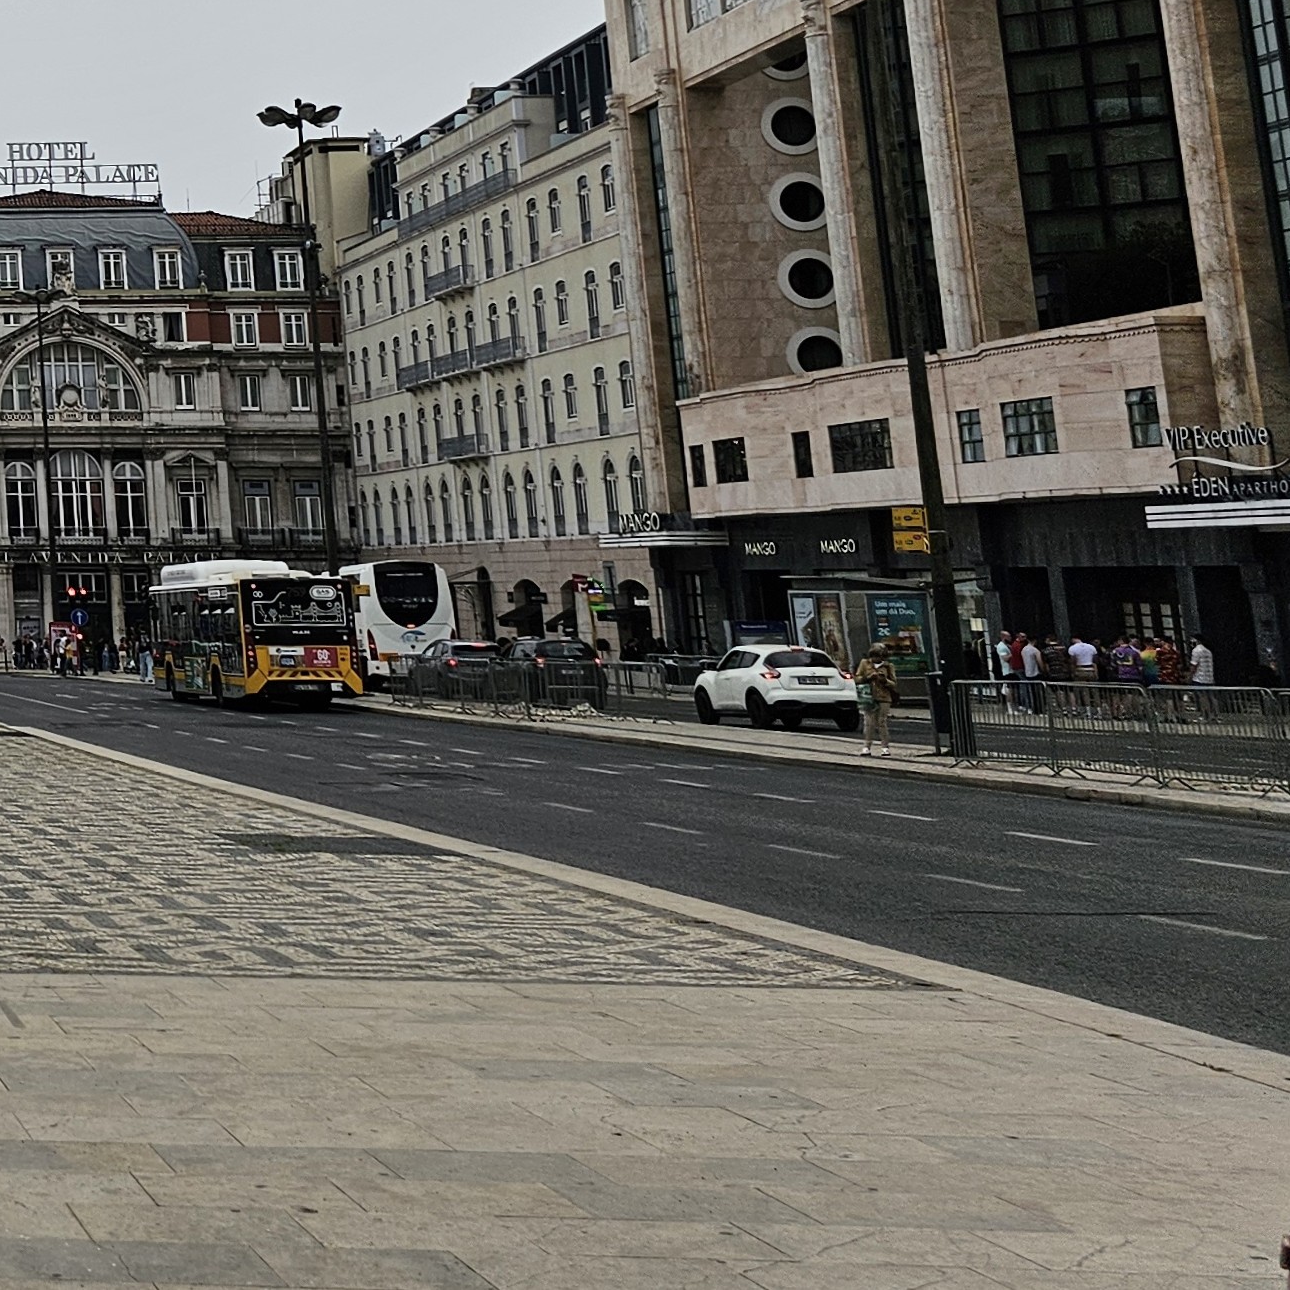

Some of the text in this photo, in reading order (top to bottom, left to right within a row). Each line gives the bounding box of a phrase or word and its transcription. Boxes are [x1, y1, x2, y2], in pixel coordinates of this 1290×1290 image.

[6, 142, 95, 160] HOTEL
[64, 164, 159, 183] PALACE
[1165, 423, 1269, 450] VIP Executive
[1191, 472, 1290, 497] ÉDEN APARTHO
[619, 512, 660, 533] MANGO
[745, 542, 776, 555] MANGO
[821, 539, 856, 554] MANGO
[28, 552, 123, 563] AVENIDA
[143, 552, 220, 563] PALACE
